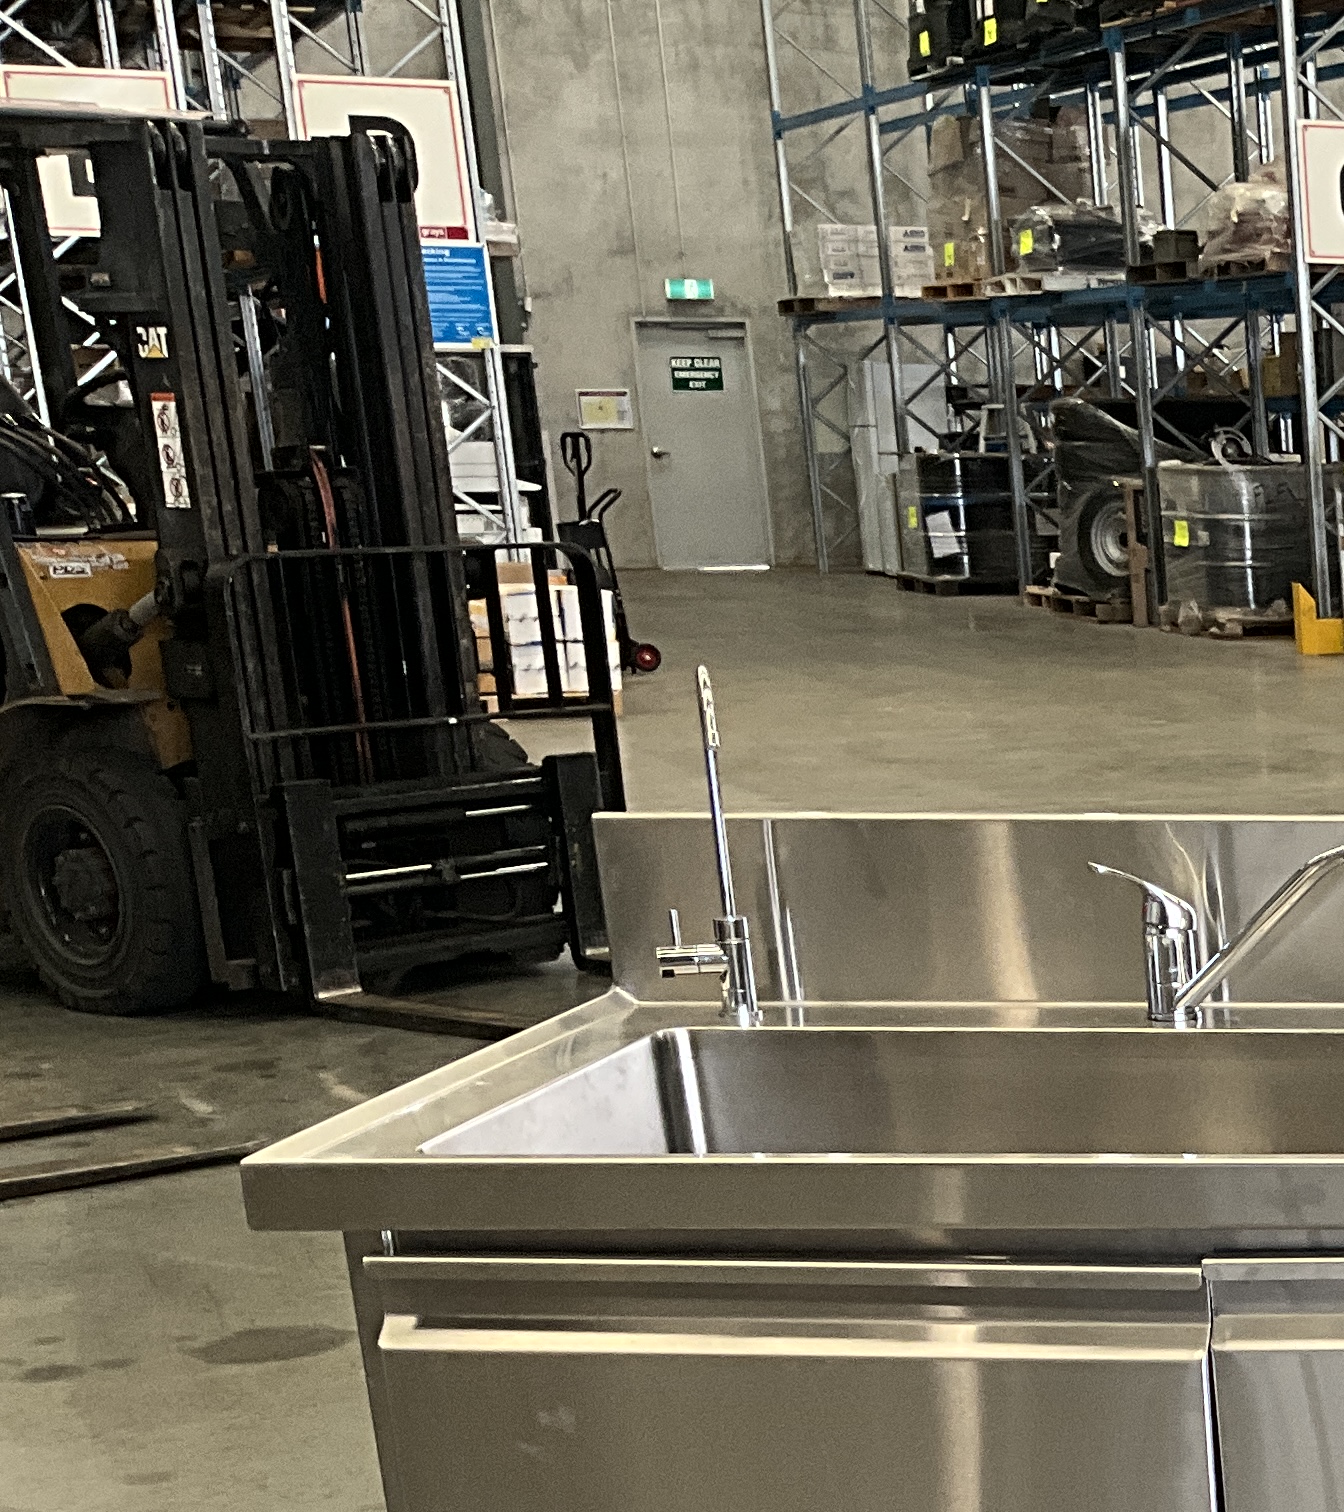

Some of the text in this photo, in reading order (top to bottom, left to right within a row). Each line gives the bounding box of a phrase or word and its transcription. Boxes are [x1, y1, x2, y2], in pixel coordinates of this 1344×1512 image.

[136, 326, 169, 359] CAT
[670, 358, 721, 369] KEEP CLEAR
[673, 370, 720, 379] EMERGENCY
